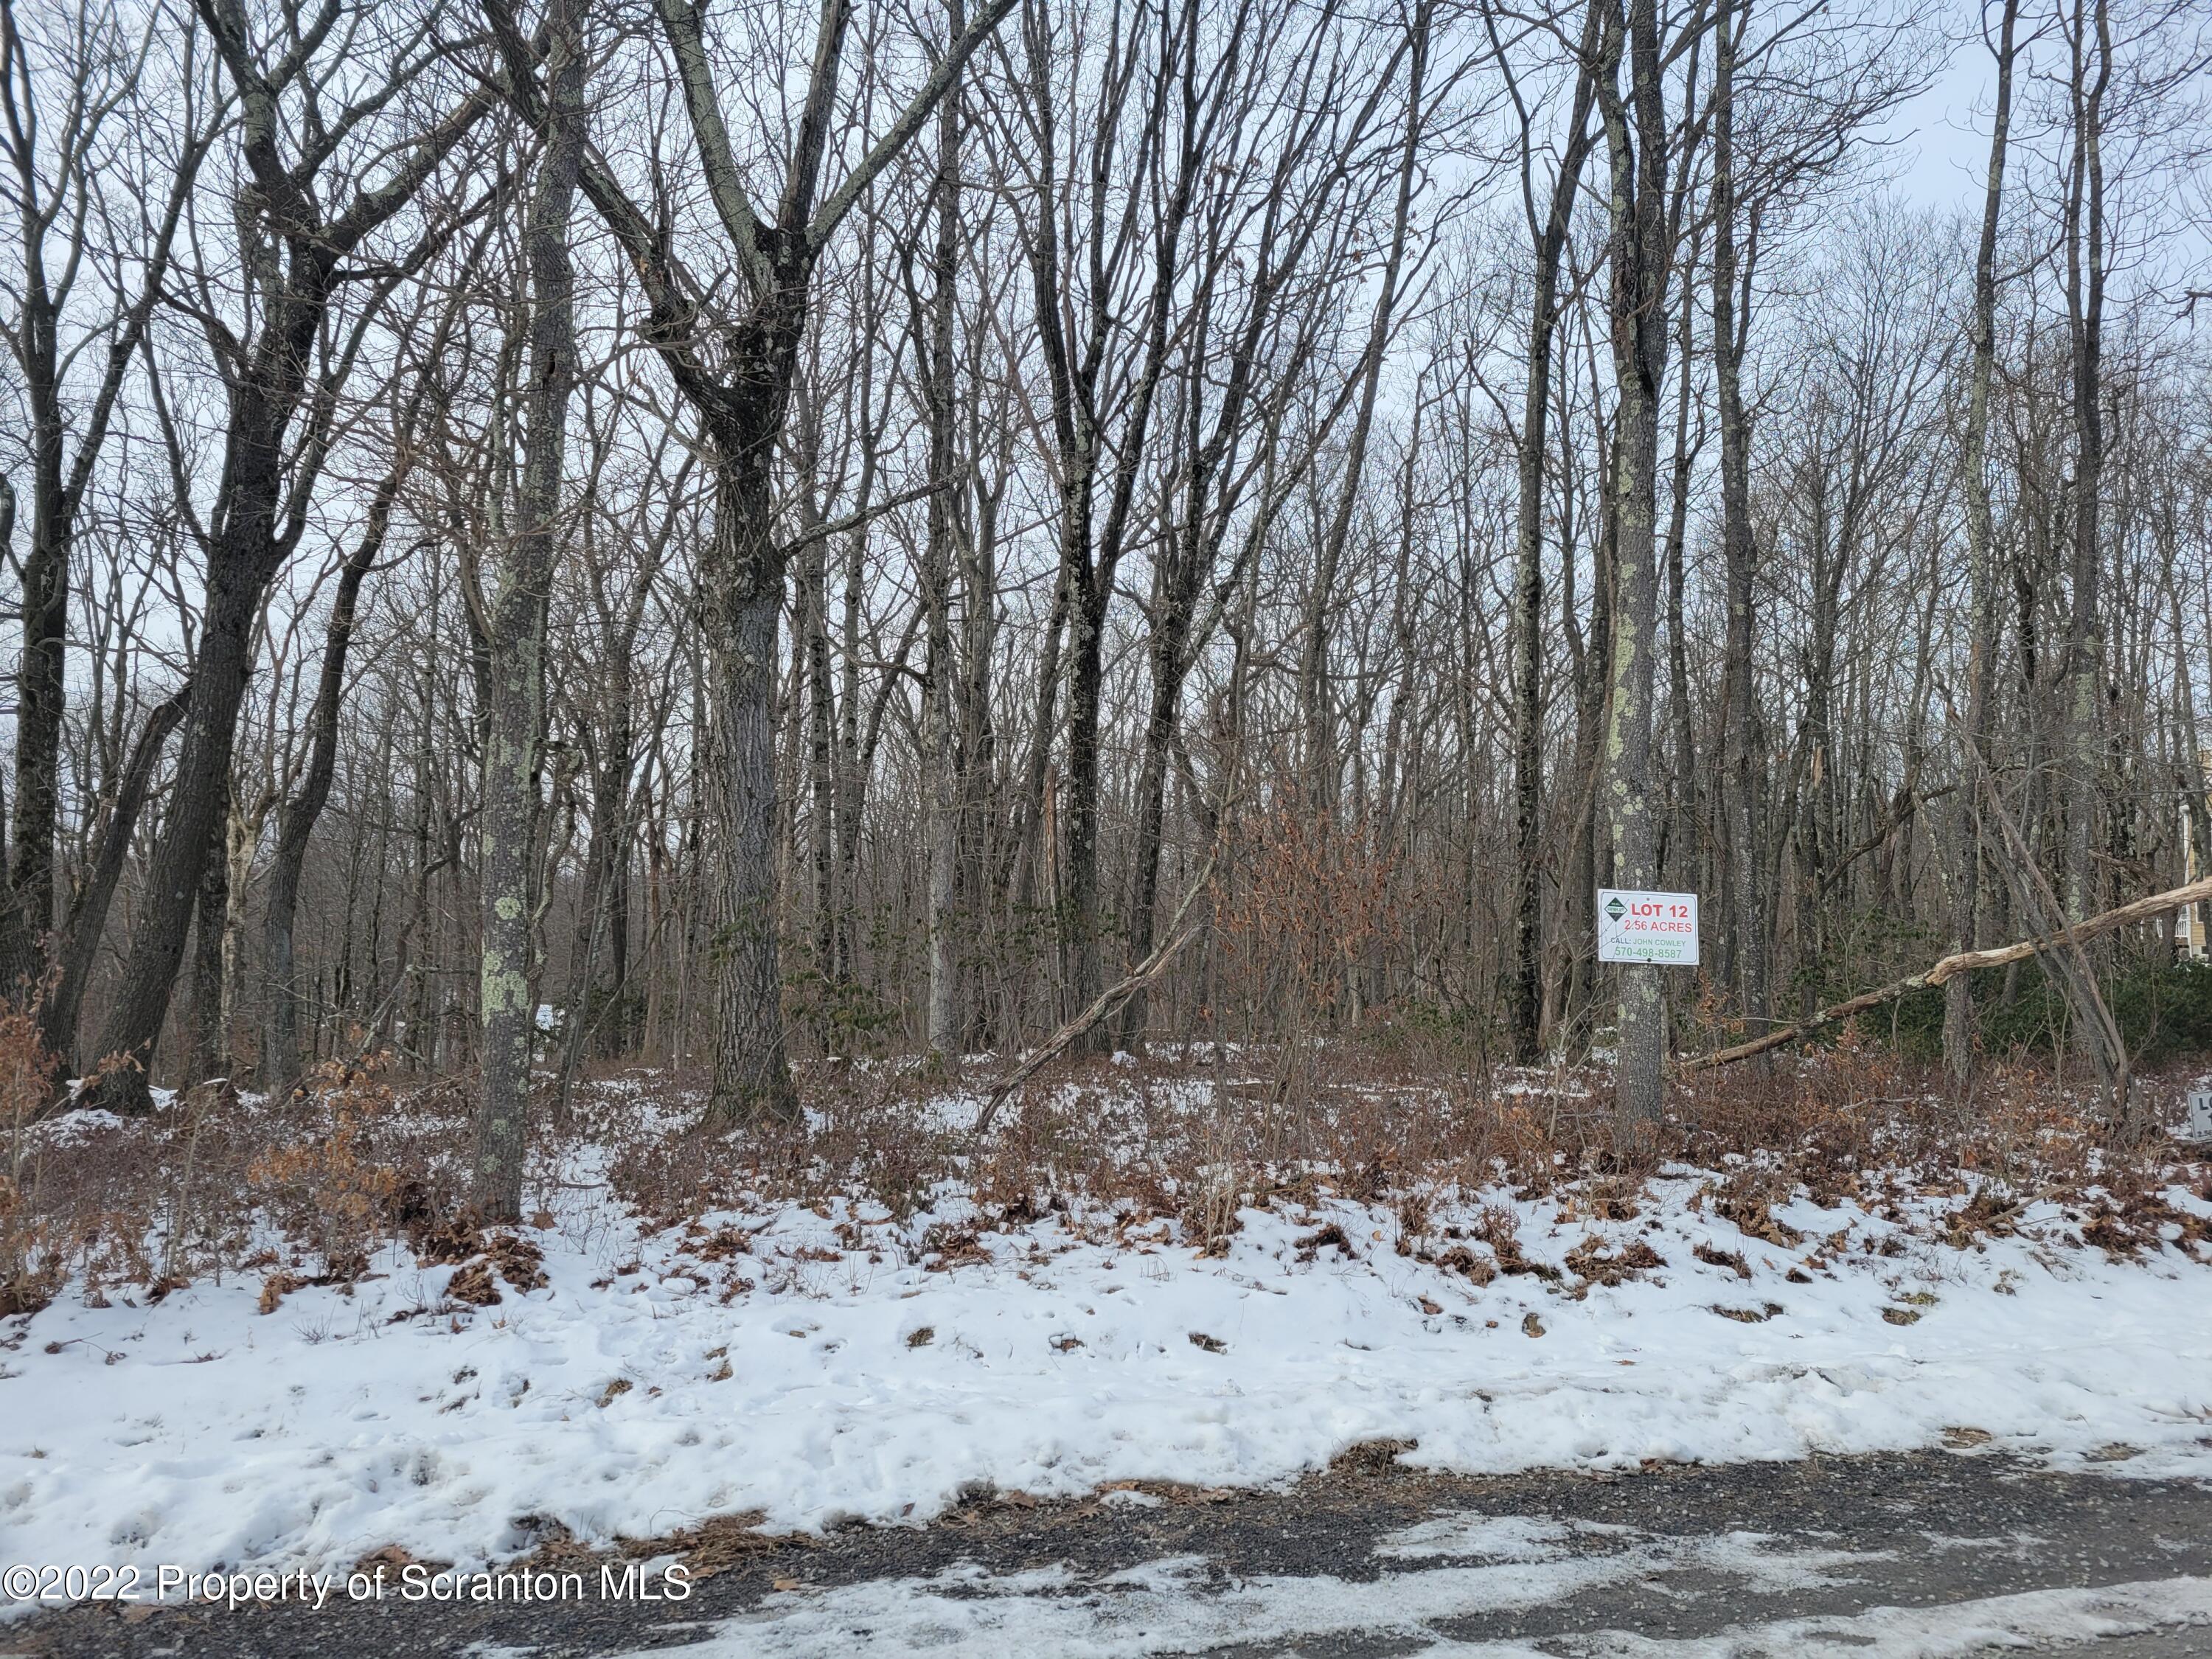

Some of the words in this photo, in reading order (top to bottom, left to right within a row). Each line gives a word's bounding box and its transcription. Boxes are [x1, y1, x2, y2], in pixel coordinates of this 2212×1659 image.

[1631, 903, 1663, 917] LOT
[1669, 905, 1688, 918] 12
[1624, 919, 1647, 931] 2.56
[1650, 922, 1692, 933] ACRES
[1655, 939, 1686, 947] COWLEY
[1615, 947, 1682, 959] 570-498-8587
